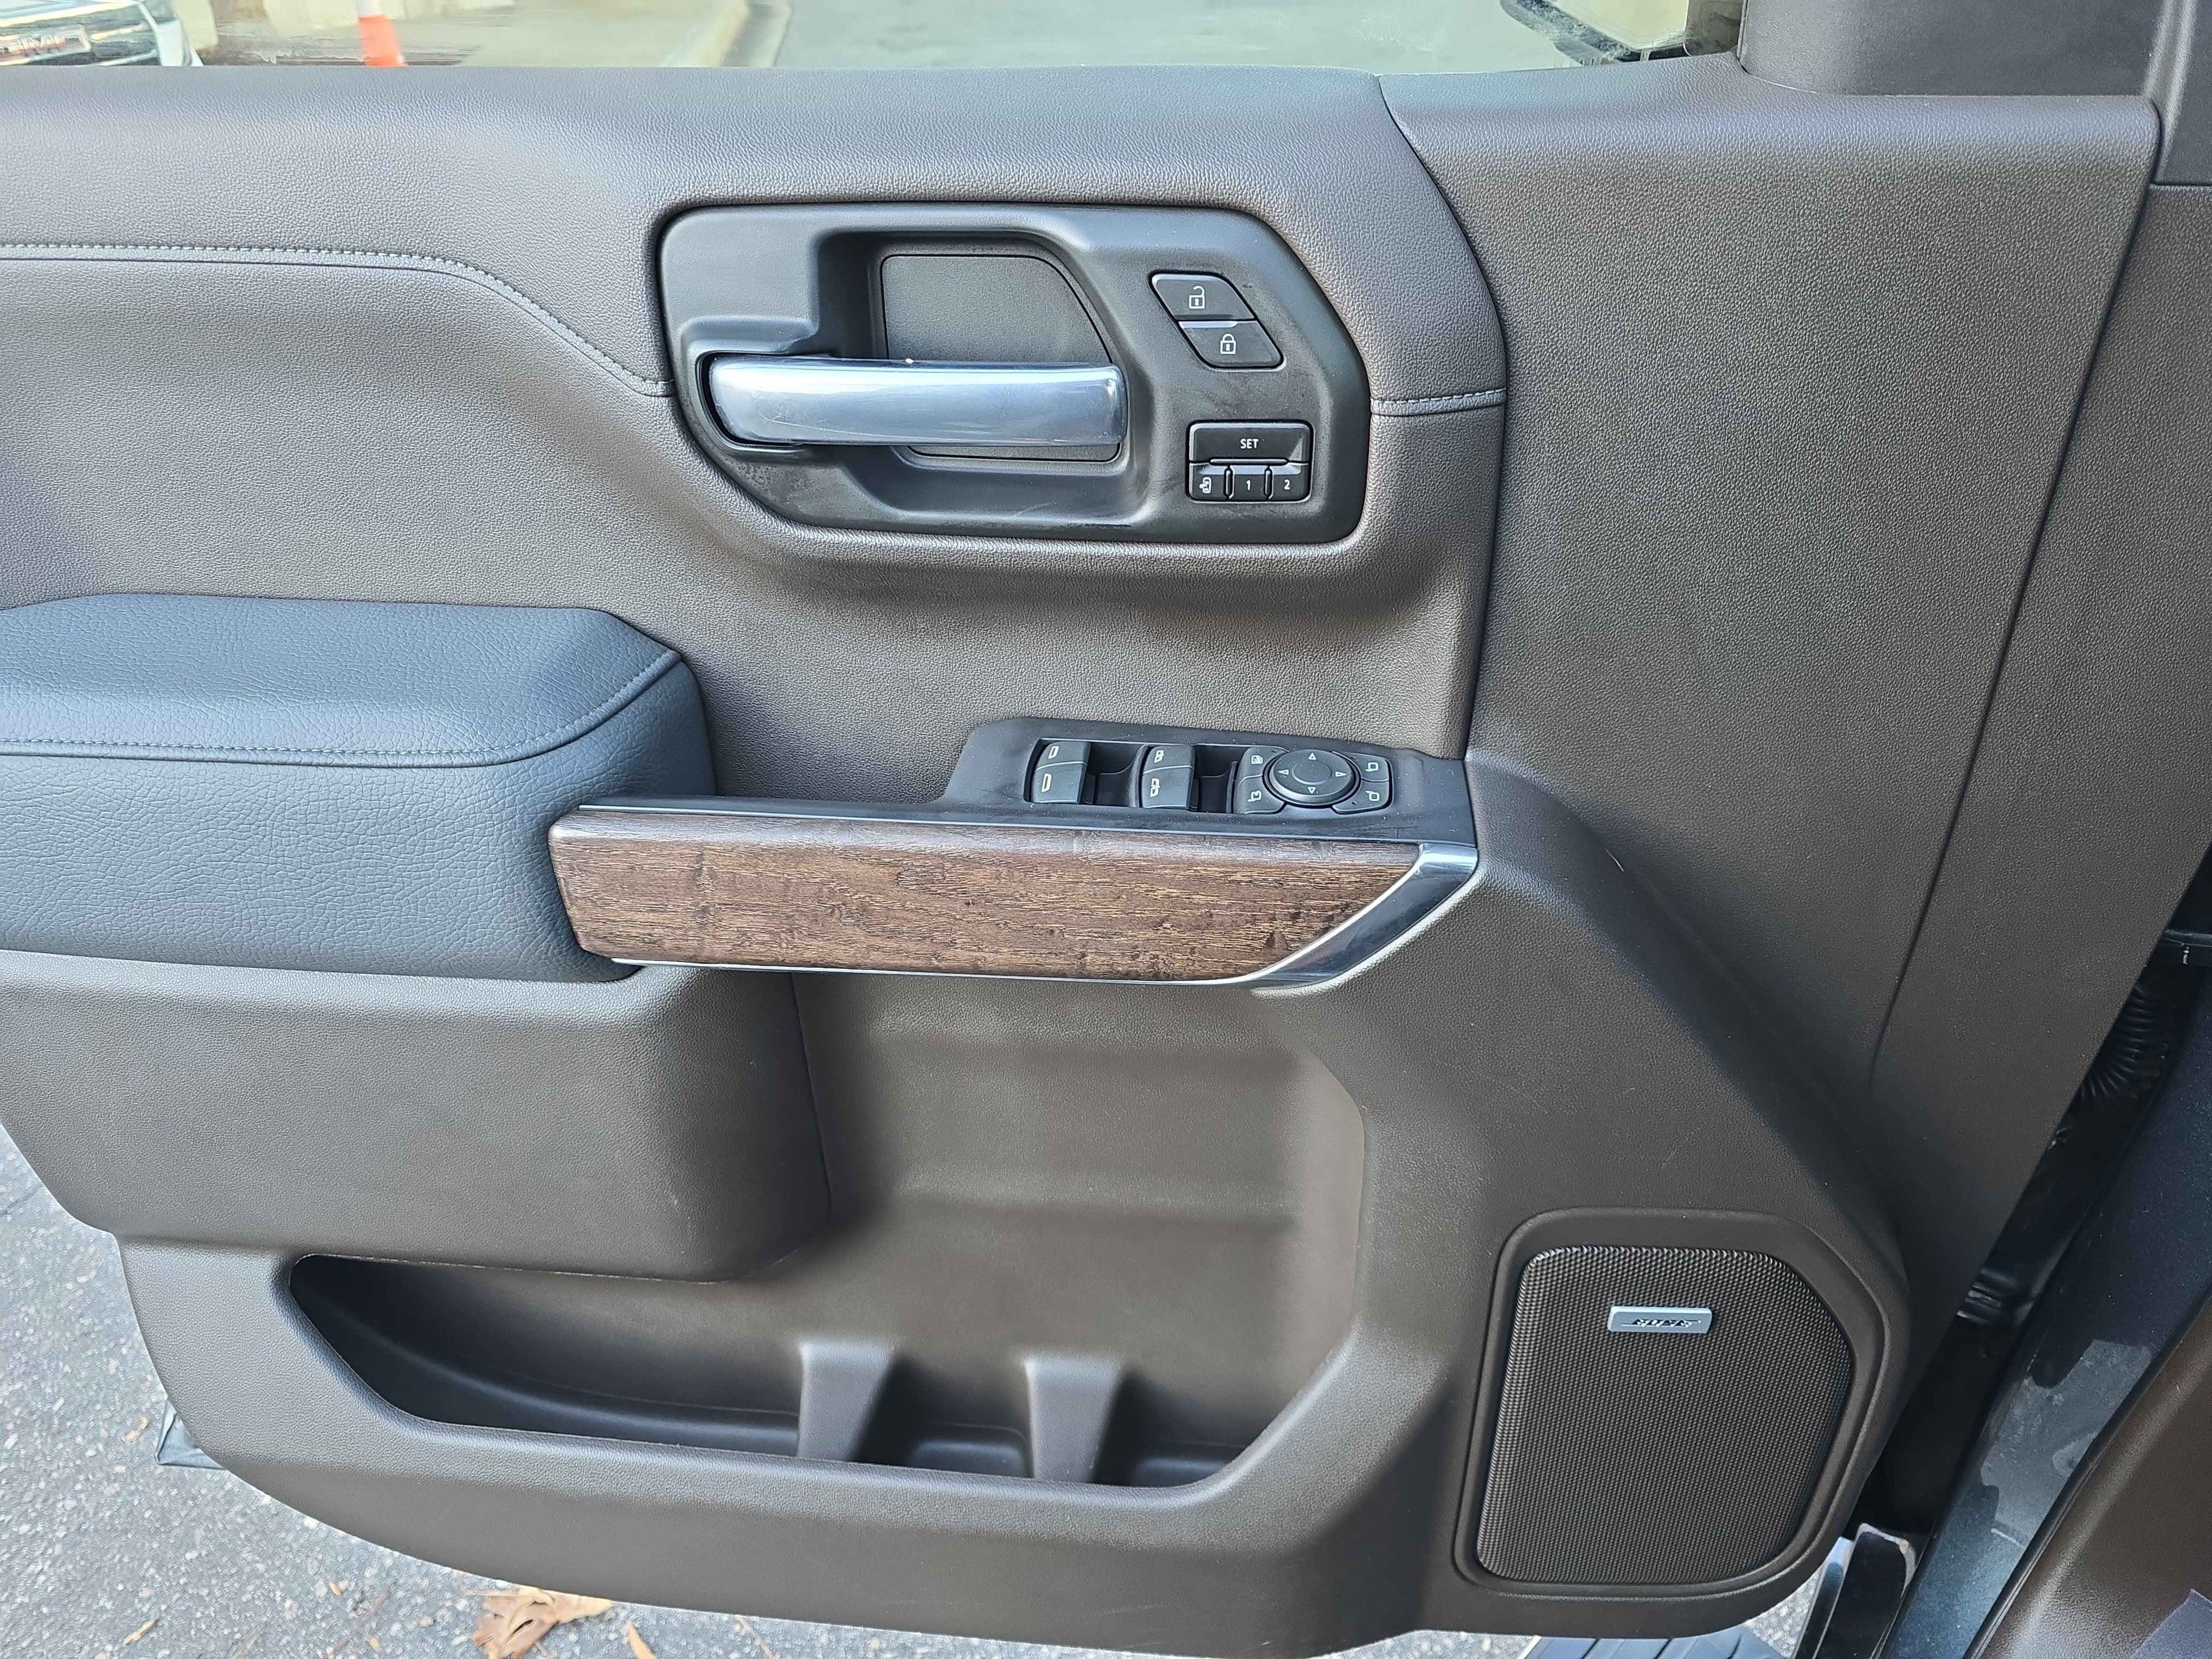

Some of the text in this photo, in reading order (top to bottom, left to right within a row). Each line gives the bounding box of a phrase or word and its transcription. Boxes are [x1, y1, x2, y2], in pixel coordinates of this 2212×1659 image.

[1240, 439, 1259, 449] SET
[1246, 480, 1251, 490] 1
[1284, 479, 1290, 490] 2
